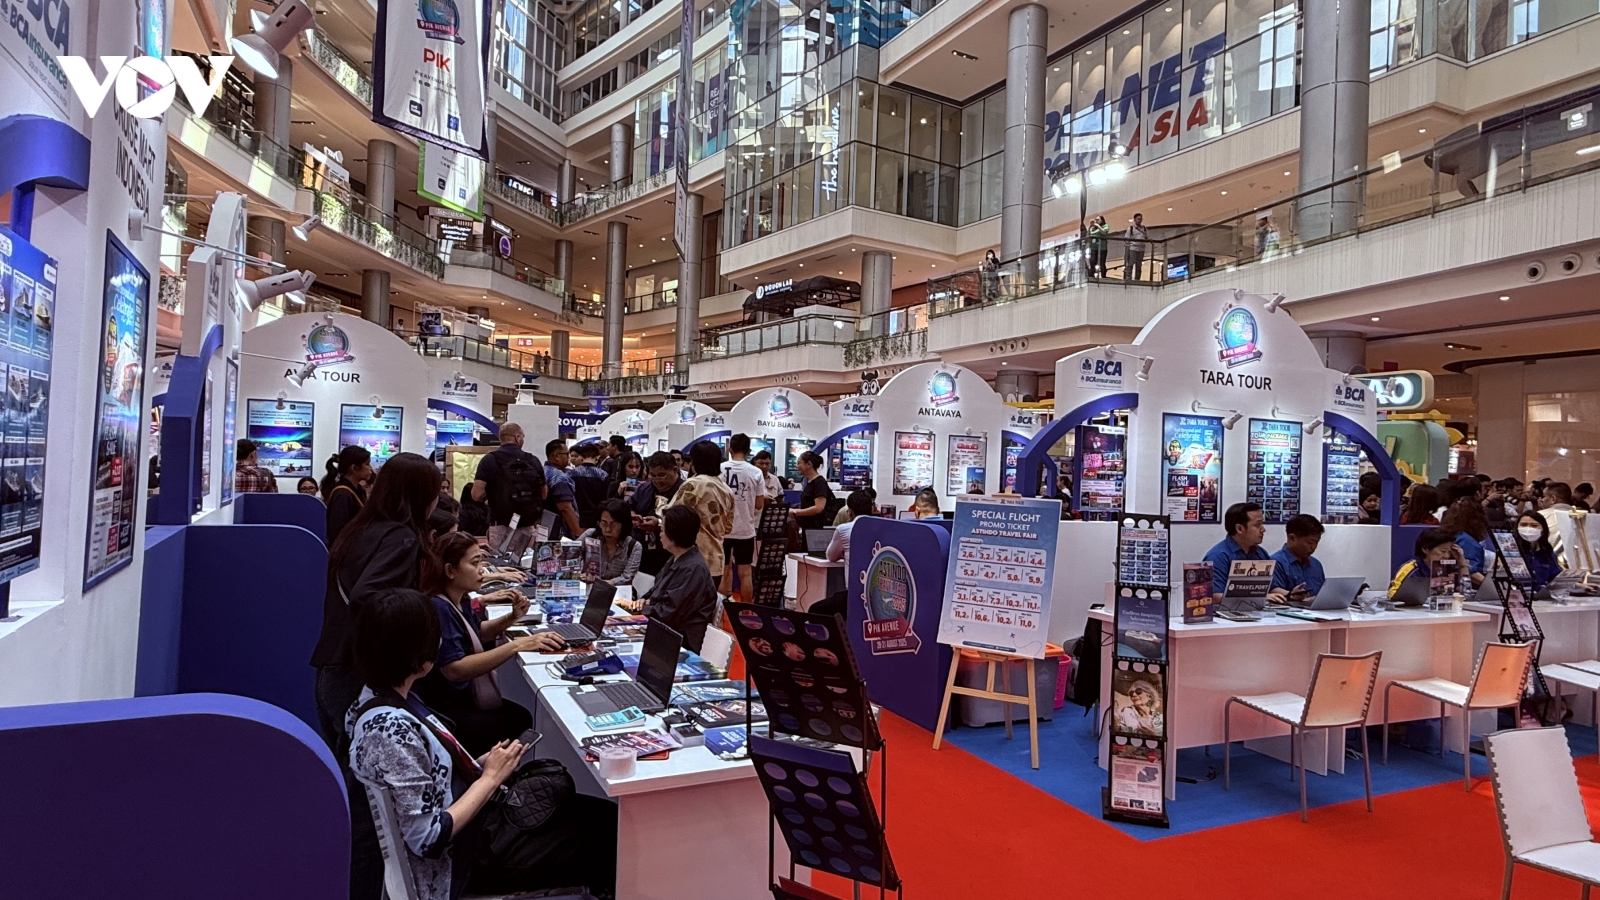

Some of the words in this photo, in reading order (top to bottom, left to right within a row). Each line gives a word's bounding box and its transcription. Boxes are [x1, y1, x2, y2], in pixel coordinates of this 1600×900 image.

[10, 4, 68, 90] BCAinsurance
[424, 48, 450, 72] PIK
[1124, 96, 1208, 156] ASIA
[138, 128, 156, 184] MART
[116, 136, 150, 223] INDONESIA
[284, 368, 317, 380] AA
[321, 371, 360, 383] TOUR
[1094, 359, 1122, 376] BCA
[1200, 370, 1234, 387] TARA
[1238, 374, 1272, 390] TOUR
[1344, 386, 1365, 402] BCA
[1368, 376, 1414, 404] AO
[918, 407, 962, 418] ANTAVAYA
[1017, 416, 1032, 424] BCA
[558, 417, 587, 427] ROYAL
[778, 421, 801, 429] BUANA
[1251, 431, 1266, 440] TOUR
[725, 467, 739, 490] LA
[971, 509, 1006, 520] SPECIAL
[1009, 512, 1041, 523] FLIGHT
[980, 521, 1005, 529] PROMO
[879, 560, 907, 582] ASTINDO
[878, 578, 895, 594] TRAVEL
[895, 582, 907, 597] FAIR
[892, 596, 906, 612] 2025
[882, 621, 899, 632] AVENUE
